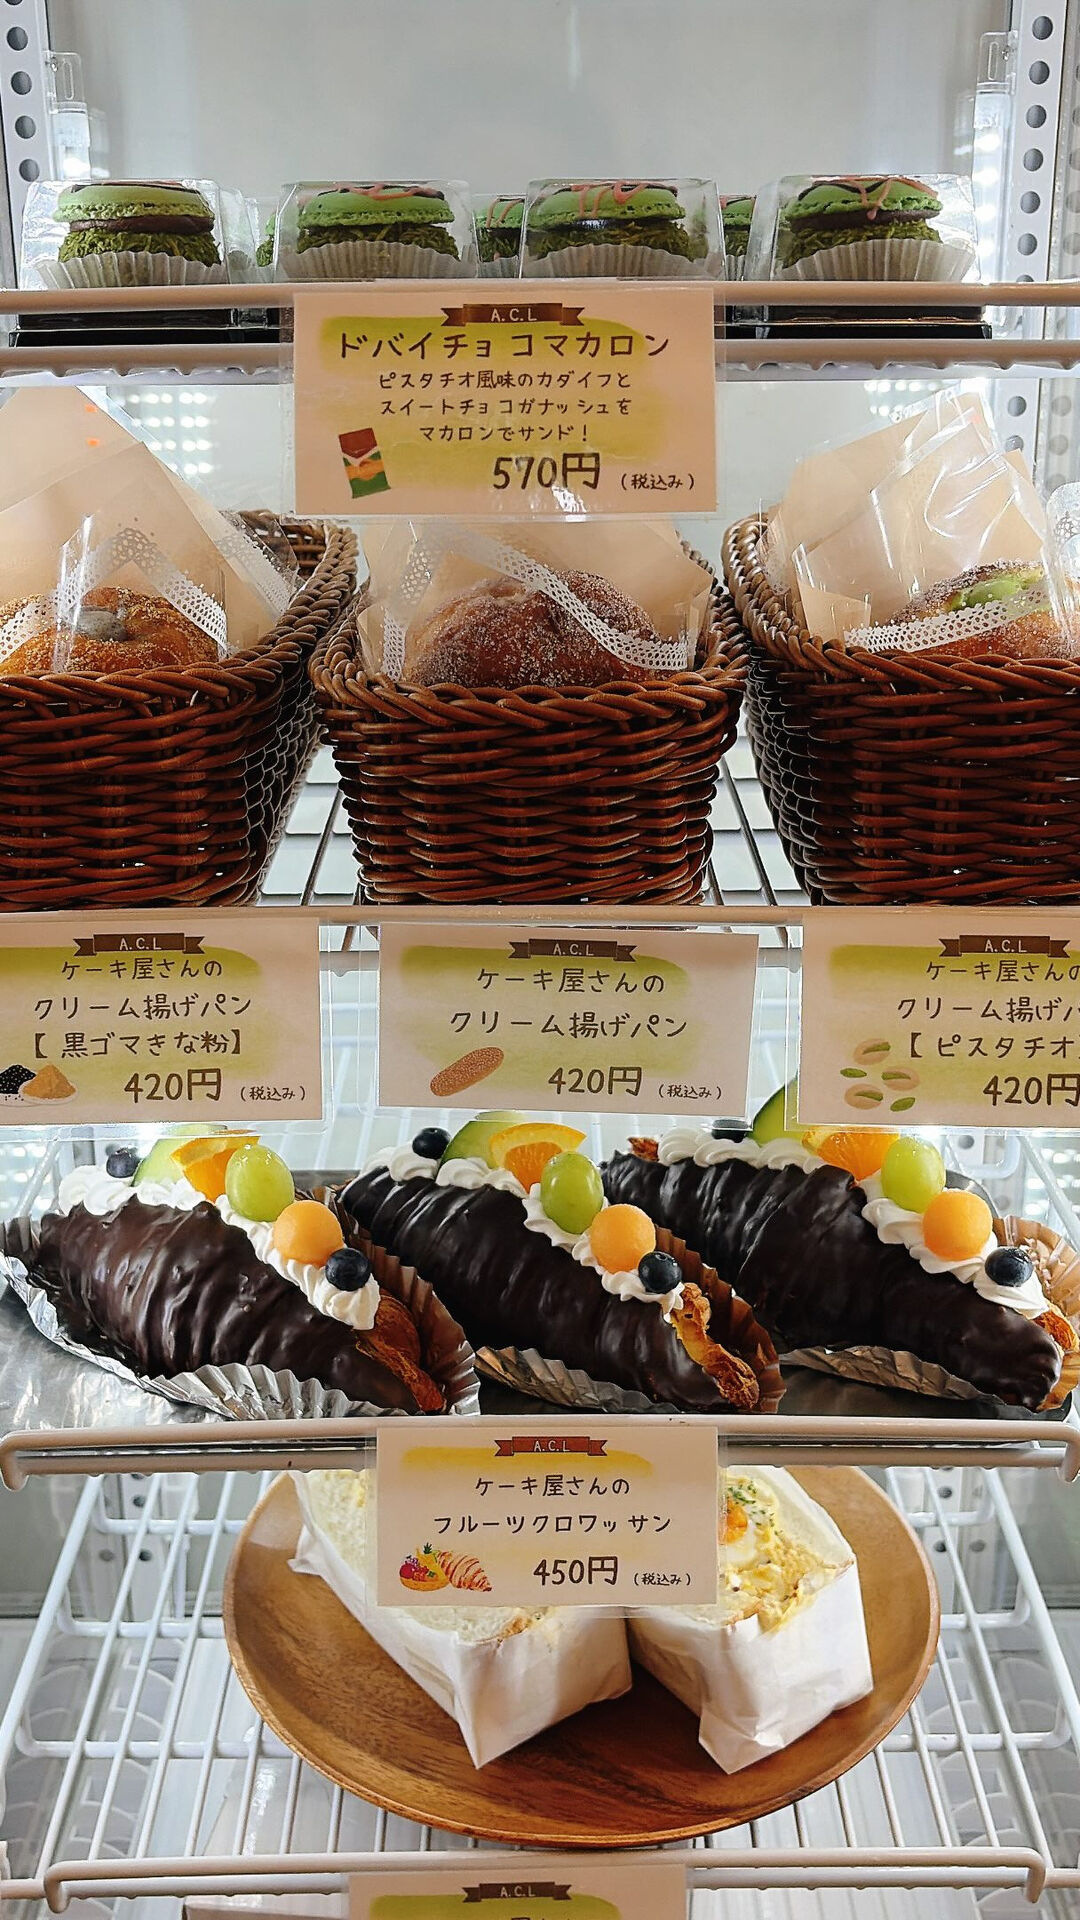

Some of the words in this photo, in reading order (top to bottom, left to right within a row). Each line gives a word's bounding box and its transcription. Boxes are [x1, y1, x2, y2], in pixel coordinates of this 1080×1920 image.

[490, 308, 538, 323] A.C.L
[339, 331, 670, 360] ドバイチョコマカロン
[379, 371, 632, 390] ピスタチオ風味のカダイフと
[380, 398, 633, 416] スイートチョコガナッシュを
[492, 452, 601, 490] 570円
[621, 473, 695, 491] (税込み)
[119, 937, 162, 951] A.C.L
[553, 943, 595, 957] A.C.L
[984, 939, 1028, 953] A.C.L
[61, 957, 223, 980] ケーキ屋さんの
[477, 968, 665, 993] ケーキ屋さんの
[34, 993, 251, 1020] クリーム揚げパン
[450, 1011, 688, 1039] クリーム揚げパン
[34, 1029, 242, 1059] 【黒ゴマきな粉】
[124, 1068, 222, 1103] 420円
[240, 1085, 306, 1101] (税込み)
[548, 1066, 642, 1096] 420円
[658, 1083, 722, 1100] (税込み)
[982, 1073, 1080, 1106] 420円
[533, 1440, 570, 1452] A.C.L
[474, 1475, 630, 1497] ケーキ屋さんの
[434, 1514, 671, 1534] フルーツクロワッサン
[533, 1556, 618, 1586] 450円
[633, 1572, 691, 1586] (税込み)
